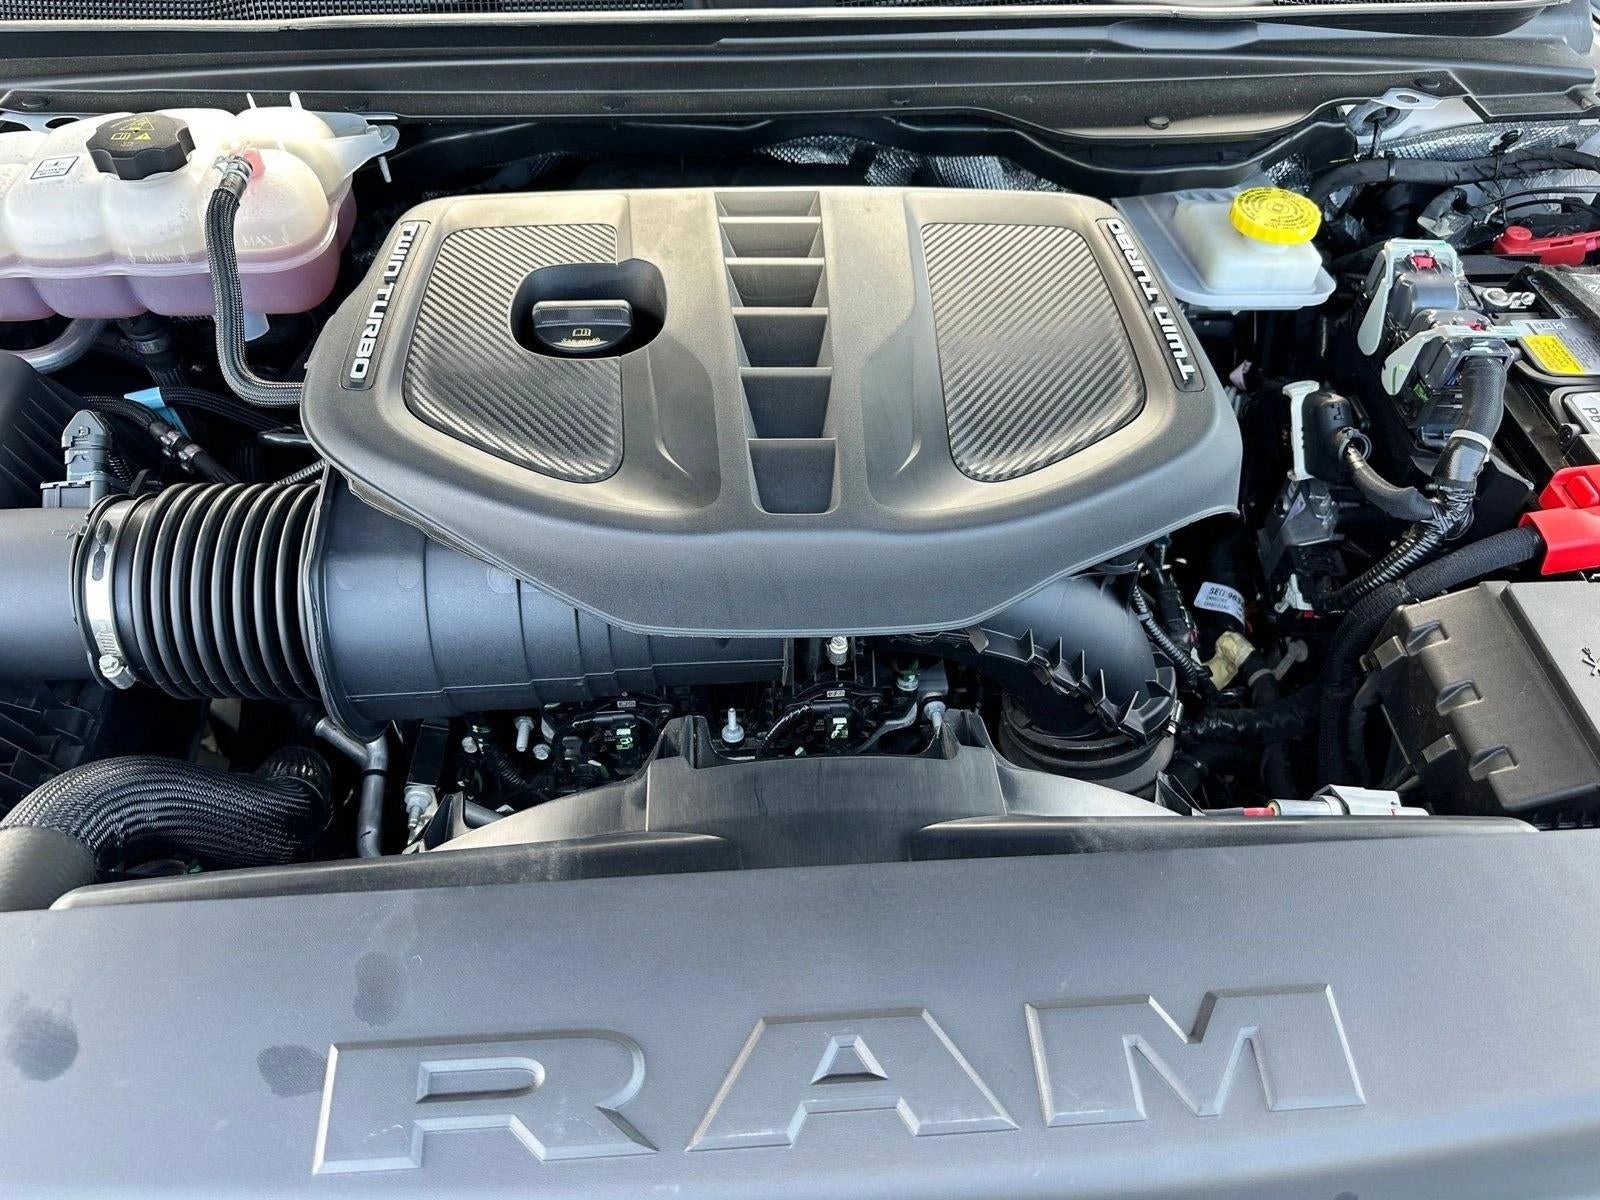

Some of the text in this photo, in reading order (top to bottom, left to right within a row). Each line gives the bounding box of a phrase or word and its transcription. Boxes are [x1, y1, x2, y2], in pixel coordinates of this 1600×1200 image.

[145, 251, 171, 262] MIN
[242, 234, 273, 247] MAX
[350, 223, 420, 380] TWIN TURBO
[1107, 218, 1195, 381] TWIN TURBO
[311, 982, 1366, 1174] RAM
